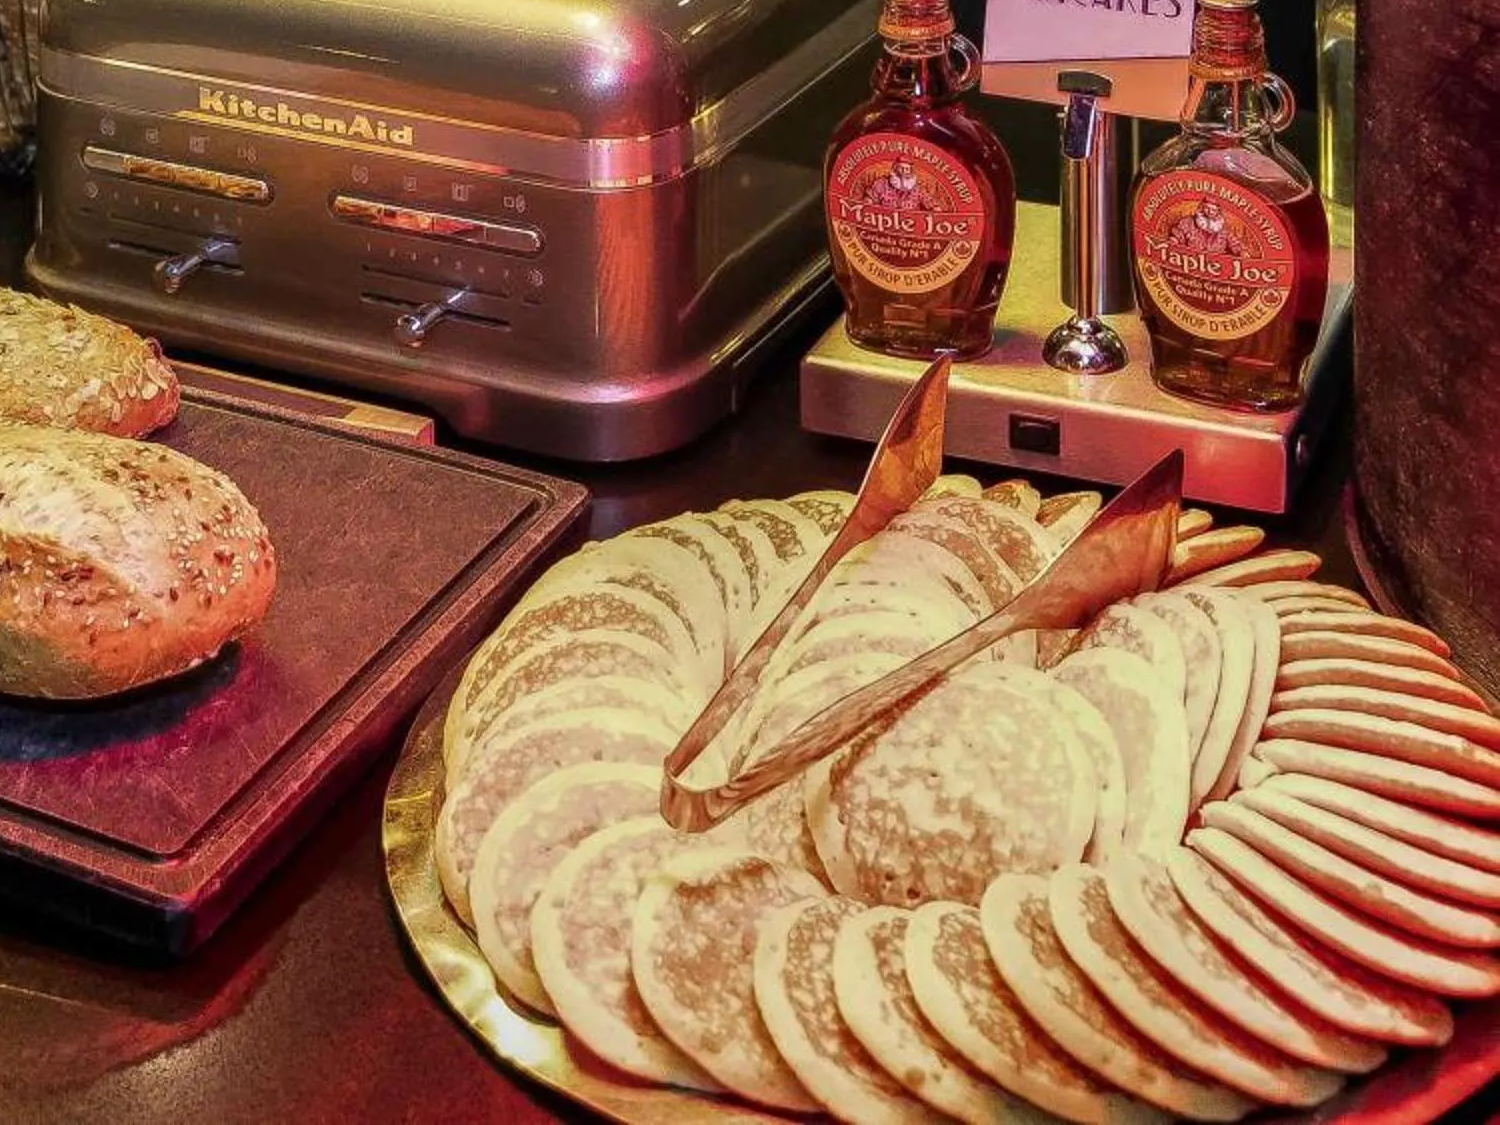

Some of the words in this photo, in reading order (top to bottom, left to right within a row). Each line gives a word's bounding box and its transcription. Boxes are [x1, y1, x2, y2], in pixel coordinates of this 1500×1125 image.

[199, 86, 414, 146] KitchenAid
[911, 145, 950, 174] MAPLE
[946, 170, 974, 204] SYRUP
[838, 196, 915, 233] Maple
[923, 215, 968, 235] Joe
[1220, 186, 1260, 218] MAPLE
[1257, 215, 1285, 251] SYRUP
[847, 242, 869, 266] PUR
[867, 262, 901, 284] SIROP
[871, 242, 907, 258] Quality
[898, 237, 931, 250] Grade
[1143, 232, 1221, 276] Maple
[1229, 260, 1278, 282] Joe
[1152, 281, 1173, 308] PUR
[1172, 303, 1206, 329] SIROP
